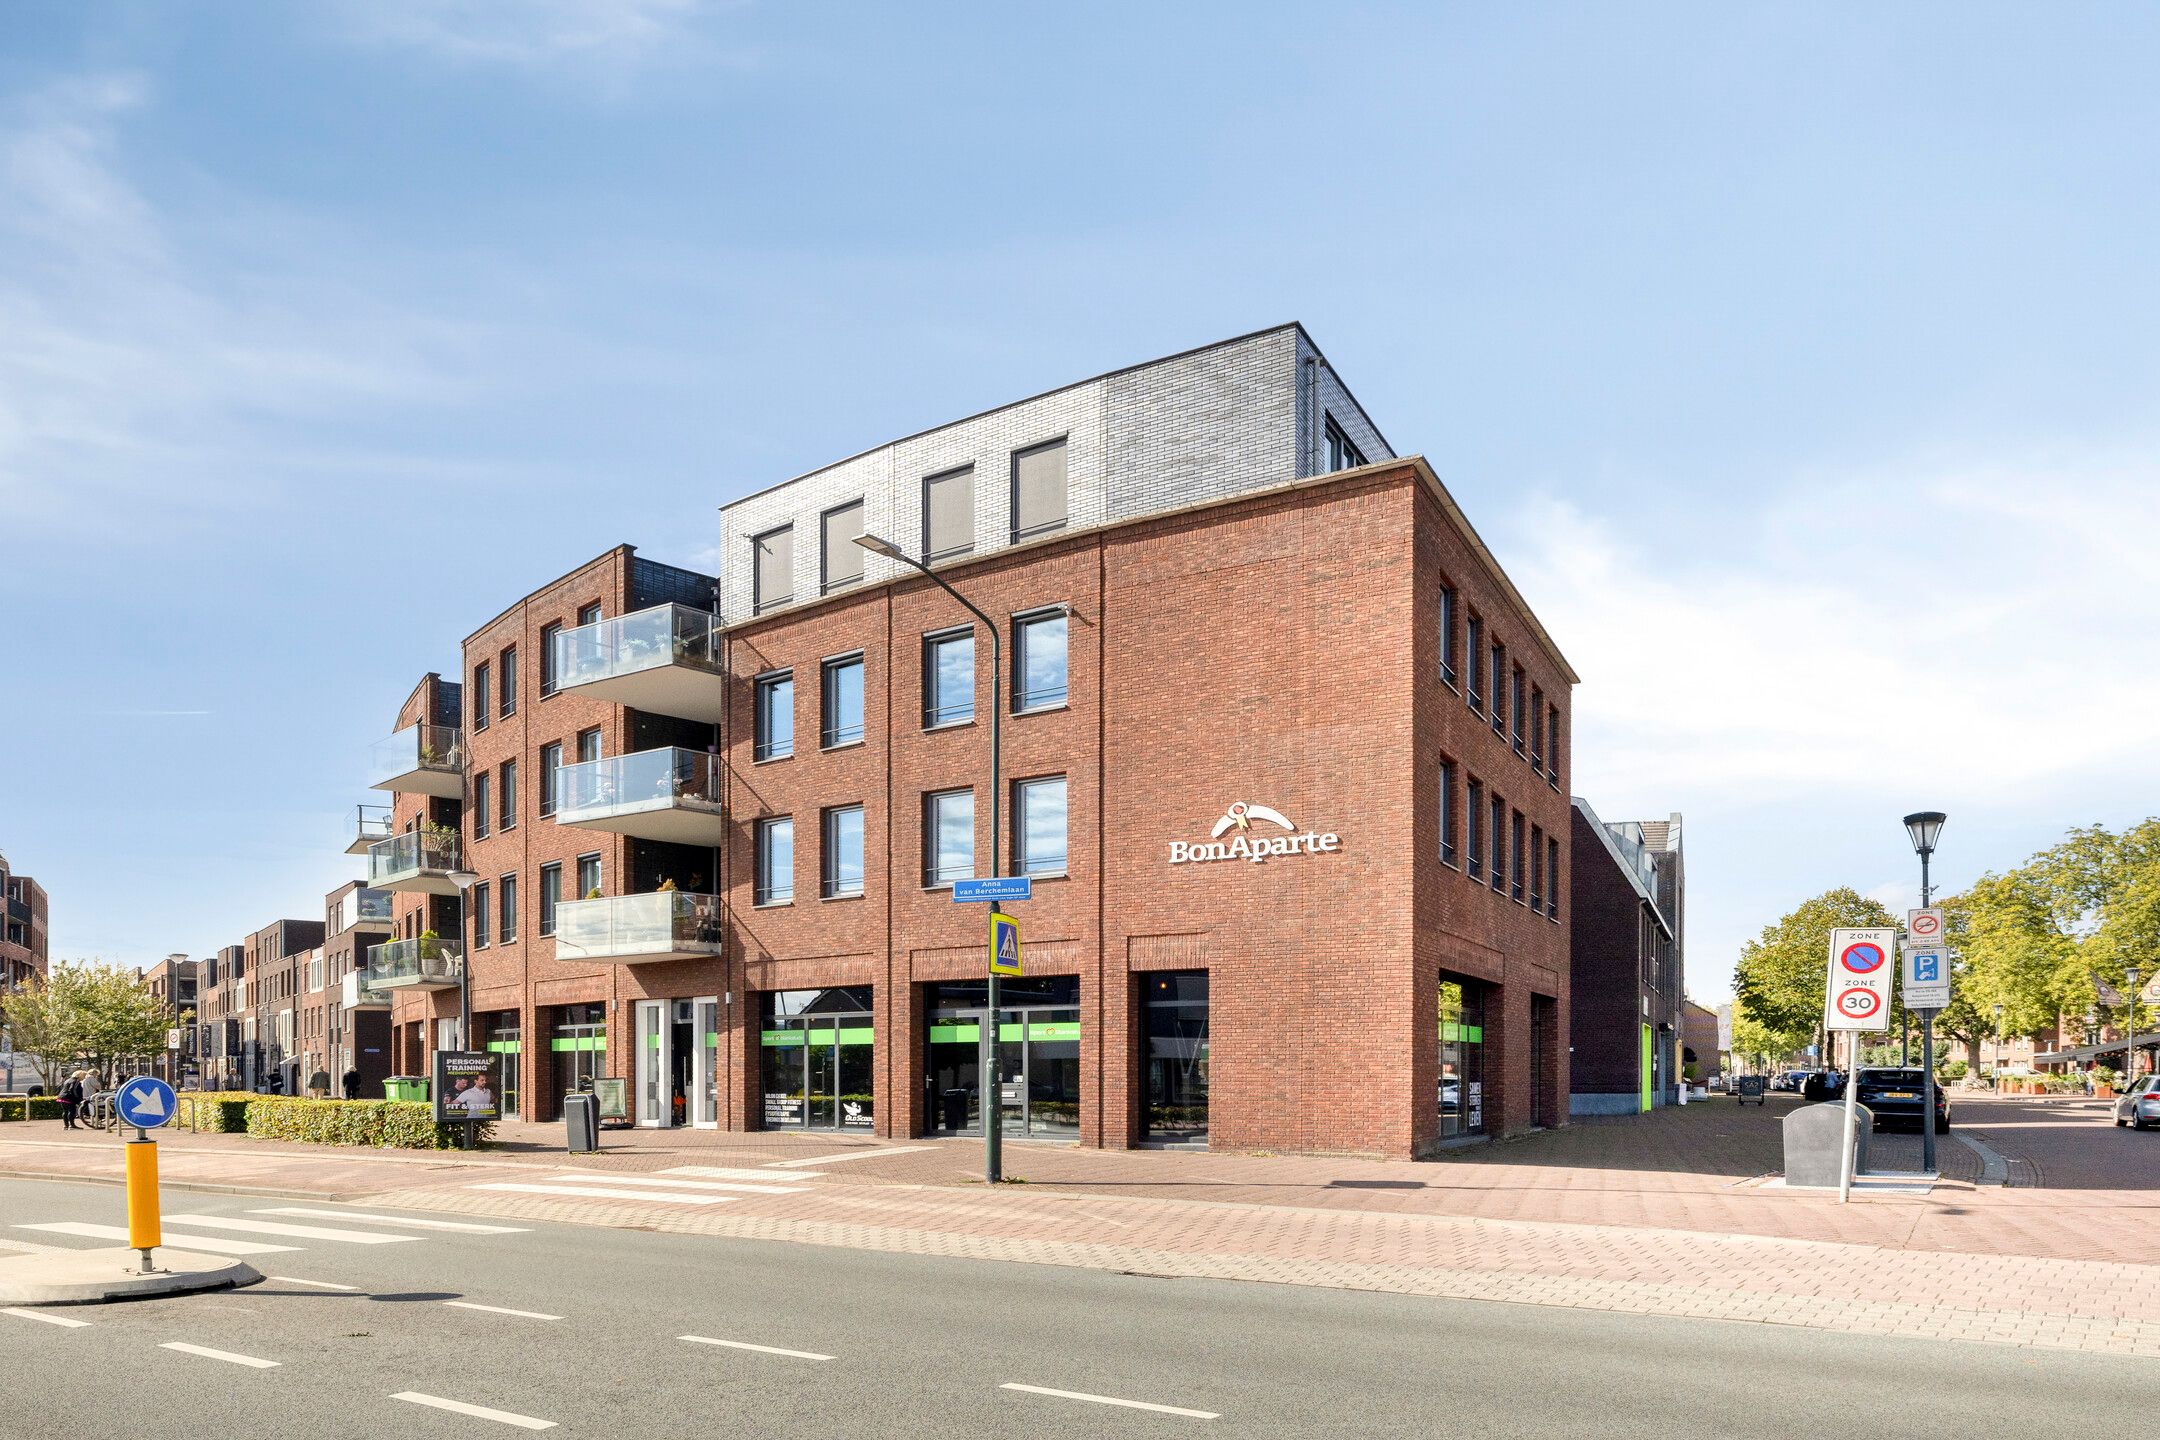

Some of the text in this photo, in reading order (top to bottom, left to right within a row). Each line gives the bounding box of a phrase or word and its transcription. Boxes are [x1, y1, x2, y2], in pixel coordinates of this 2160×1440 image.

[1168, 830, 1338, 863] BonAparte
[975, 887, 1025, 895] Berchemlaan
[1845, 997, 1871, 1009] 30
